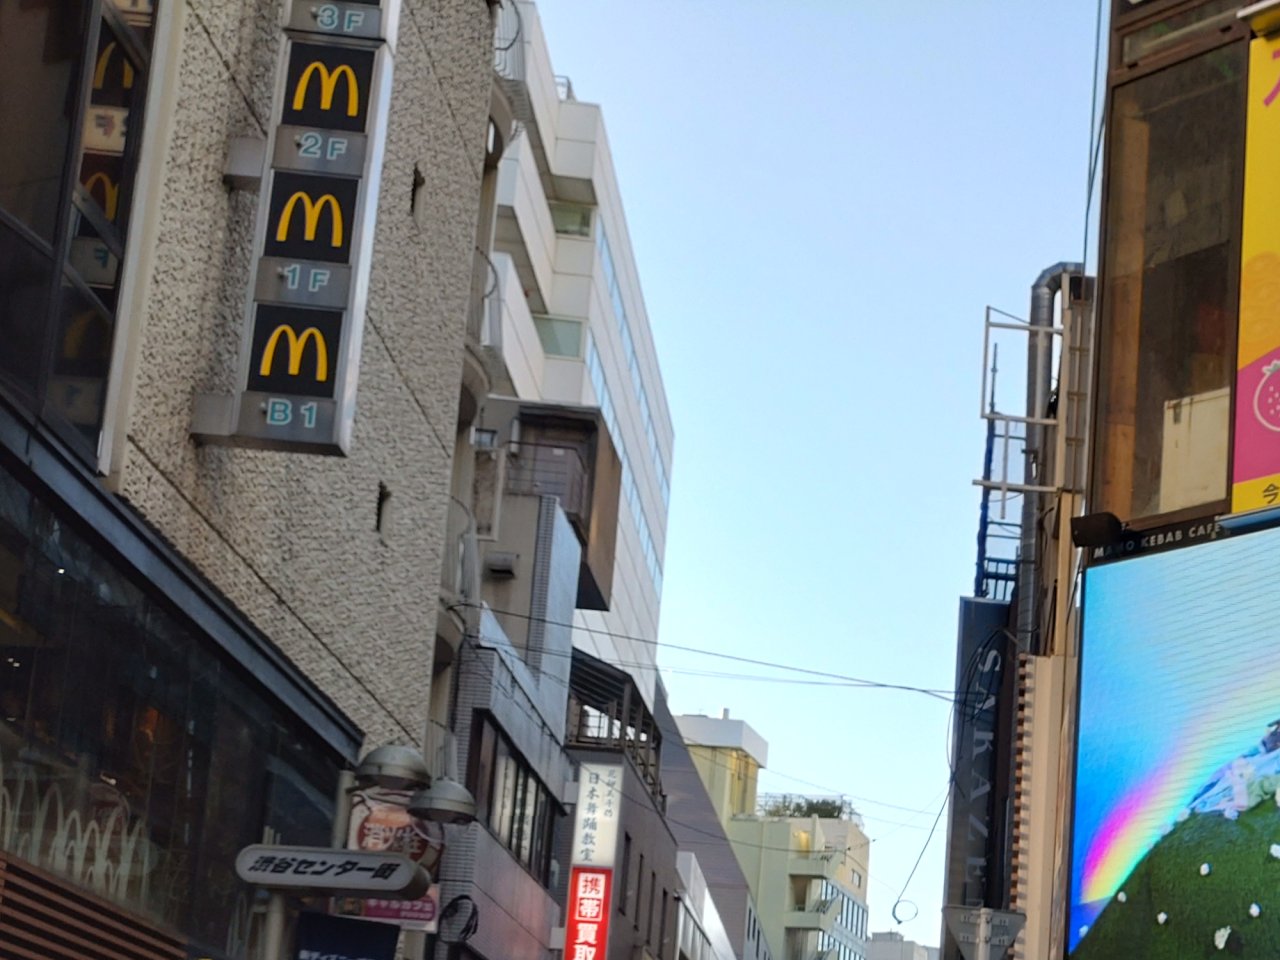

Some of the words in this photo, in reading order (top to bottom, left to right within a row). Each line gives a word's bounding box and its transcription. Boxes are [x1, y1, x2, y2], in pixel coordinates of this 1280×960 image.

[301, 135, 347, 161] 2F
[286, 265, 330, 292] 1F
[1140, 529, 1183, 549] KEBAB
[248, 856, 402, 881] 渋谷センター街
